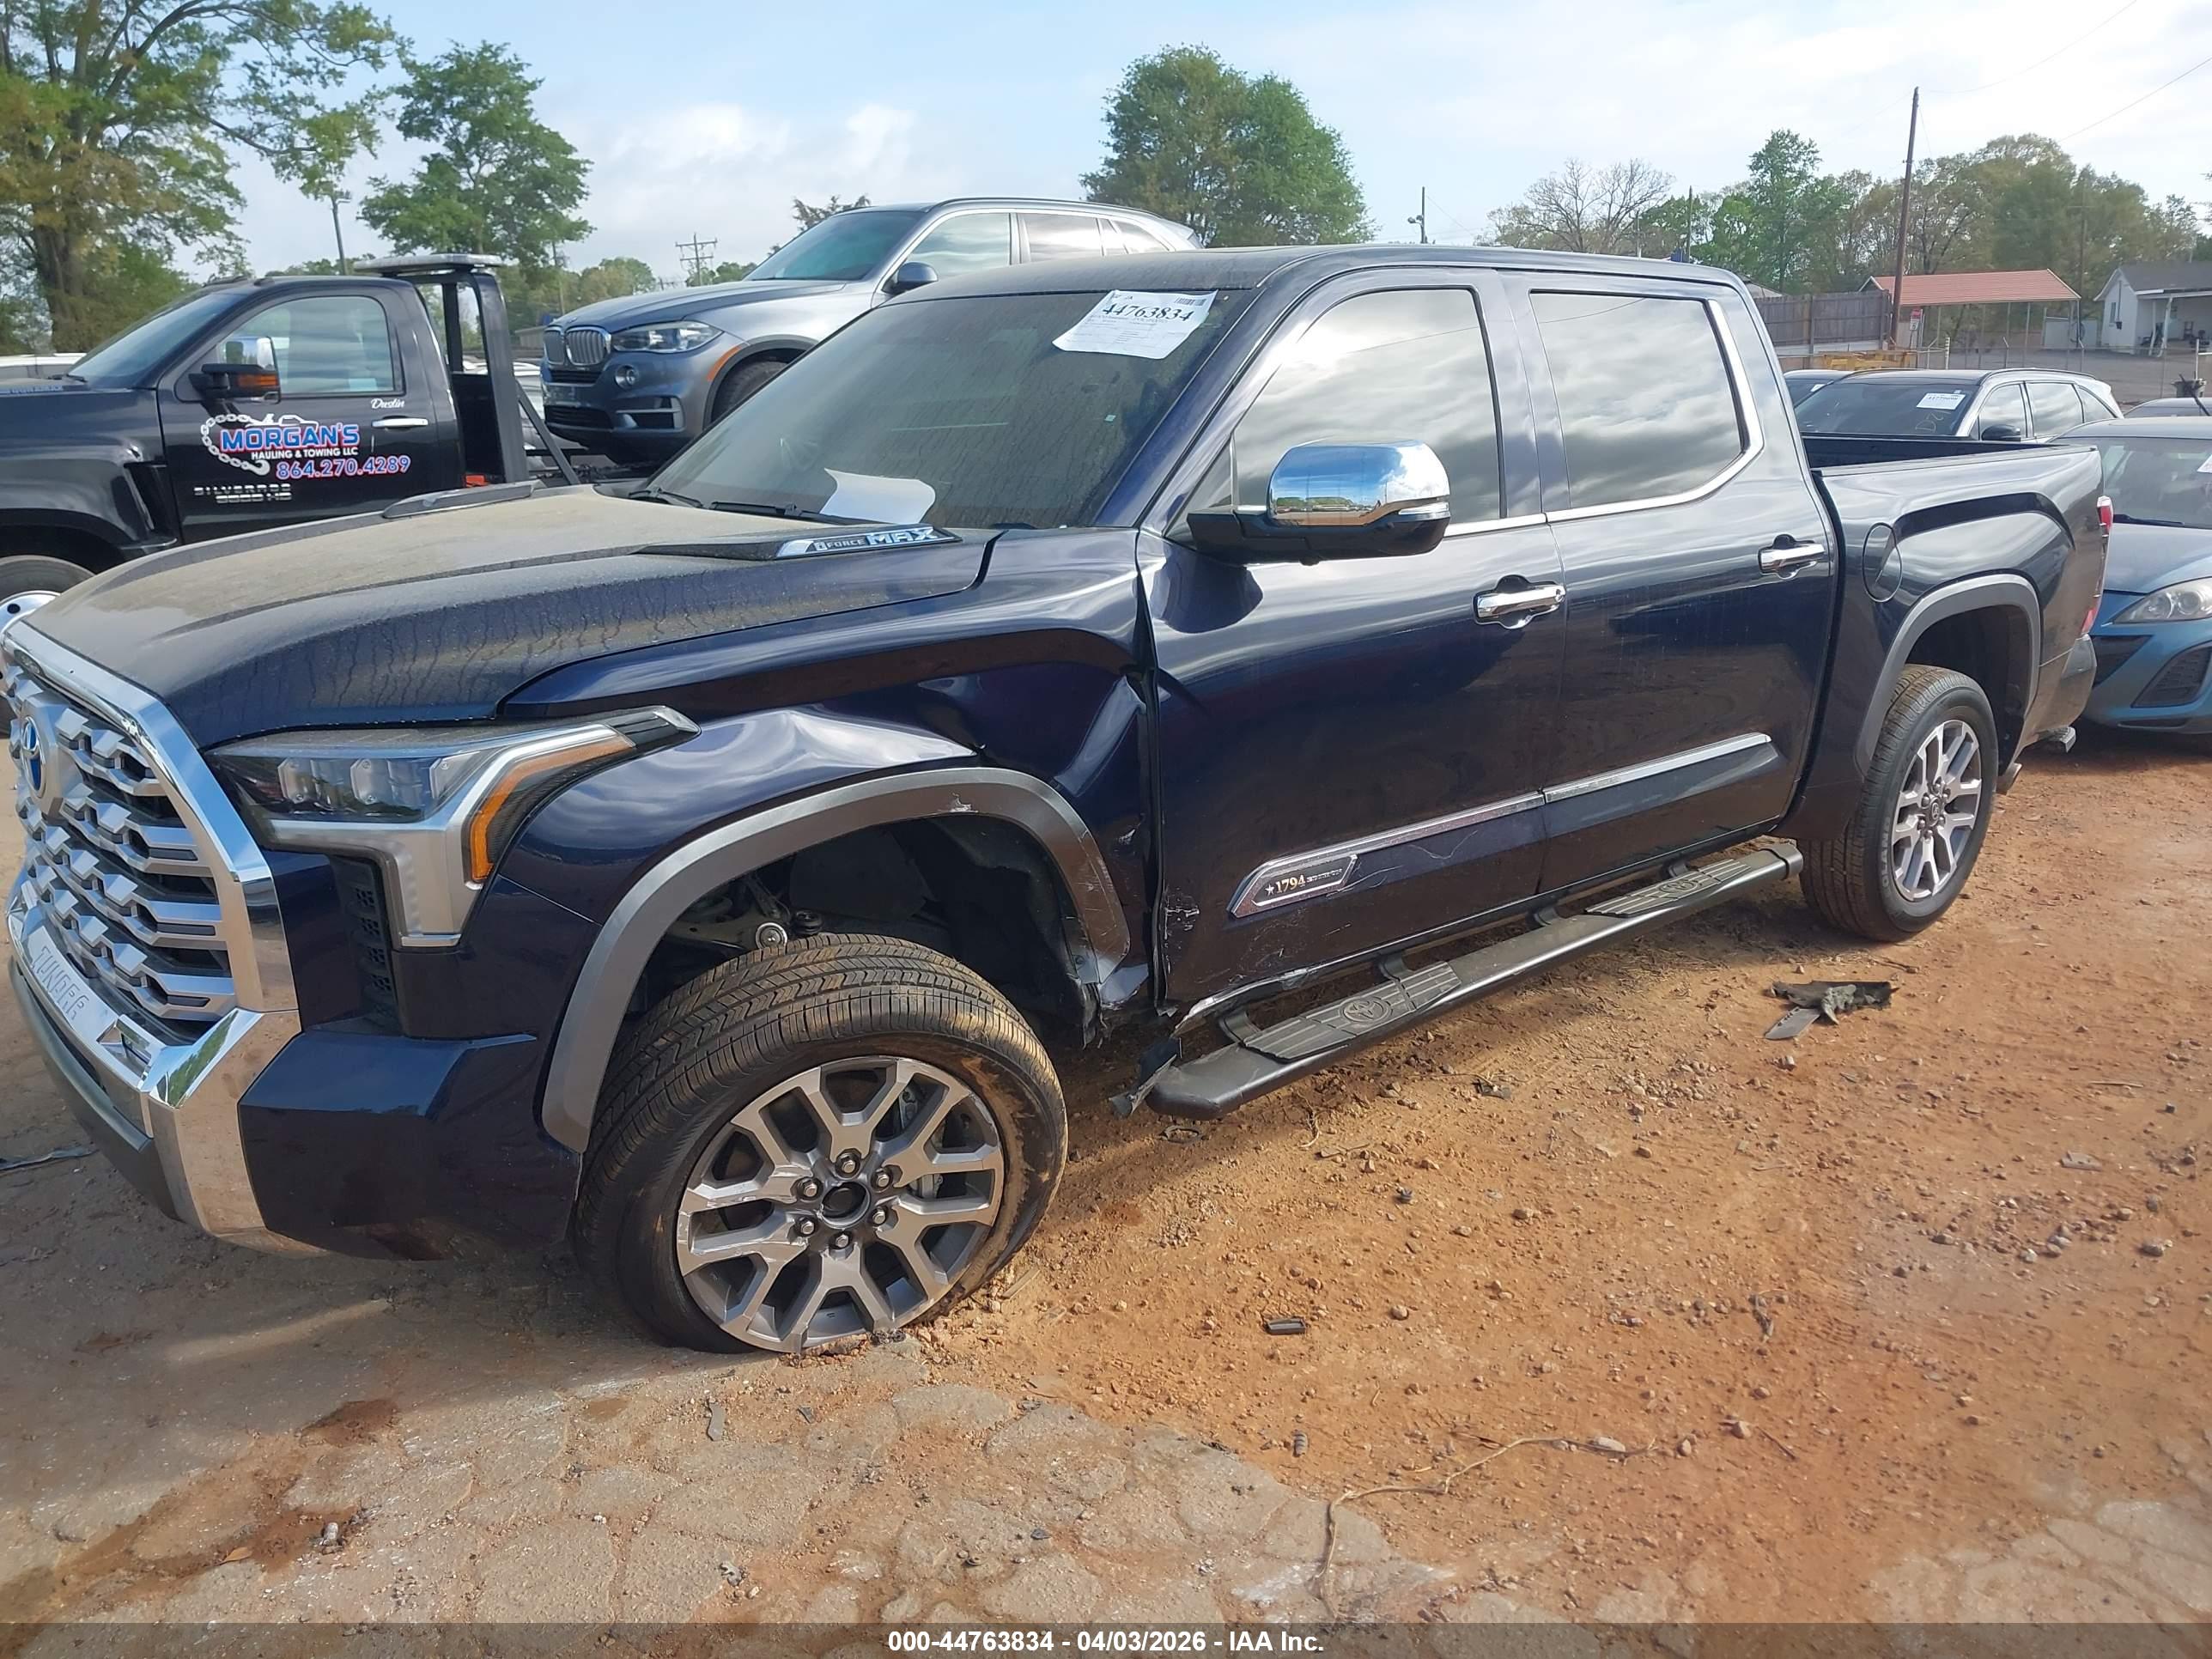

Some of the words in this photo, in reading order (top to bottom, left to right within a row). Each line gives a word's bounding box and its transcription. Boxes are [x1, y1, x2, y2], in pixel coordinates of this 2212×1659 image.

[1103, 303, 1194, 321] 44763834
[371, 398, 405, 409] Dustin
[220, 423, 360, 452] MORGAN'S
[252, 450, 293, 460] HAULING
[295, 449, 302, 458] &
[304, 447, 341, 458] TOWING
[343, 447, 358, 456] LLC
[276, 455, 411, 480] 864.270.4289
[866, 527, 938, 545] MAX
[1275, 874, 1306, 893] 1794
[33, 946, 89, 1020] TUNDRA
